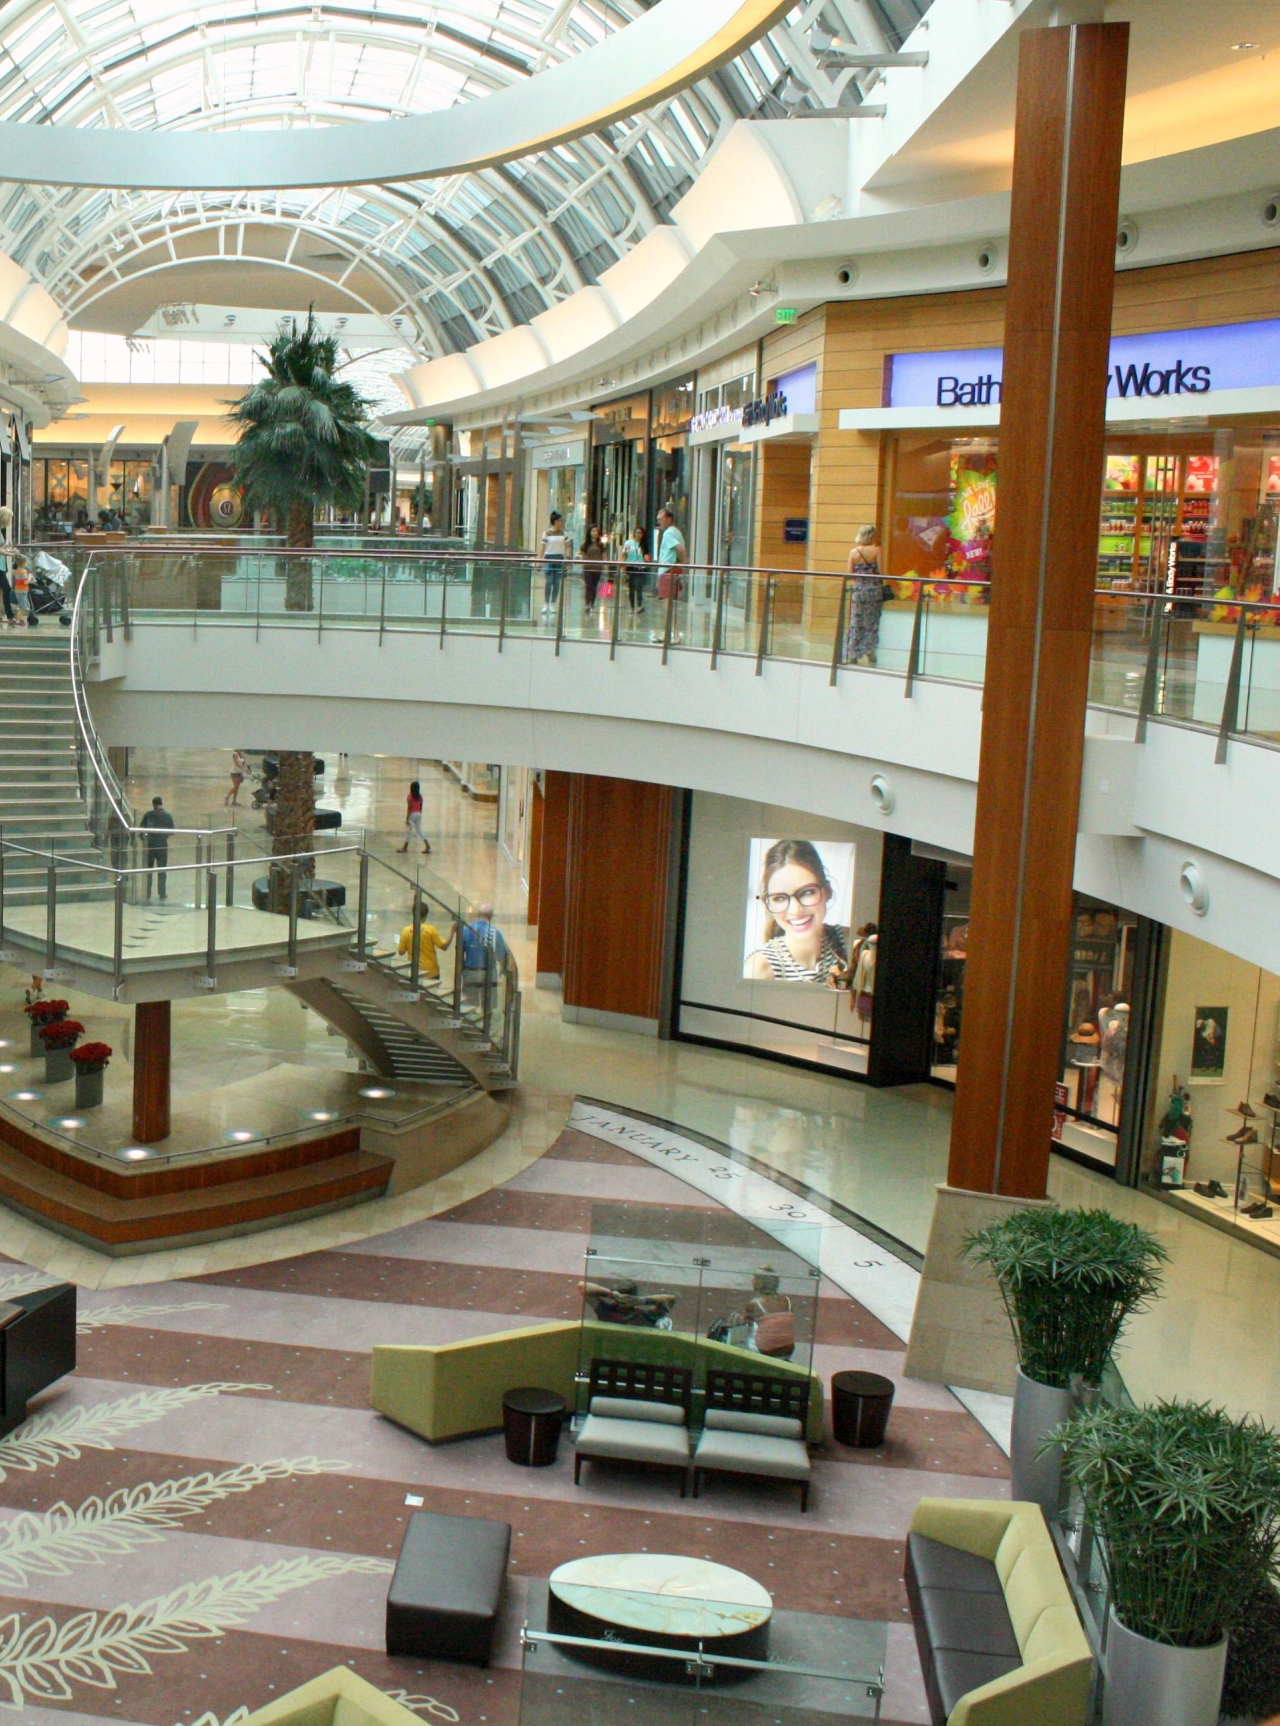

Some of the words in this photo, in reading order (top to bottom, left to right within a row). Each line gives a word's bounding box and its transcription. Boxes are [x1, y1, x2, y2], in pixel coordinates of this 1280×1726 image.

[937, 374, 1002, 407] Bath
[1115, 360, 1211, 397] Works
[571, 1115, 699, 1163] JANUARY
[708, 1166, 743, 1181] 25
[768, 1203, 807, 1219] 30
[853, 1260, 885, 1269] 5
